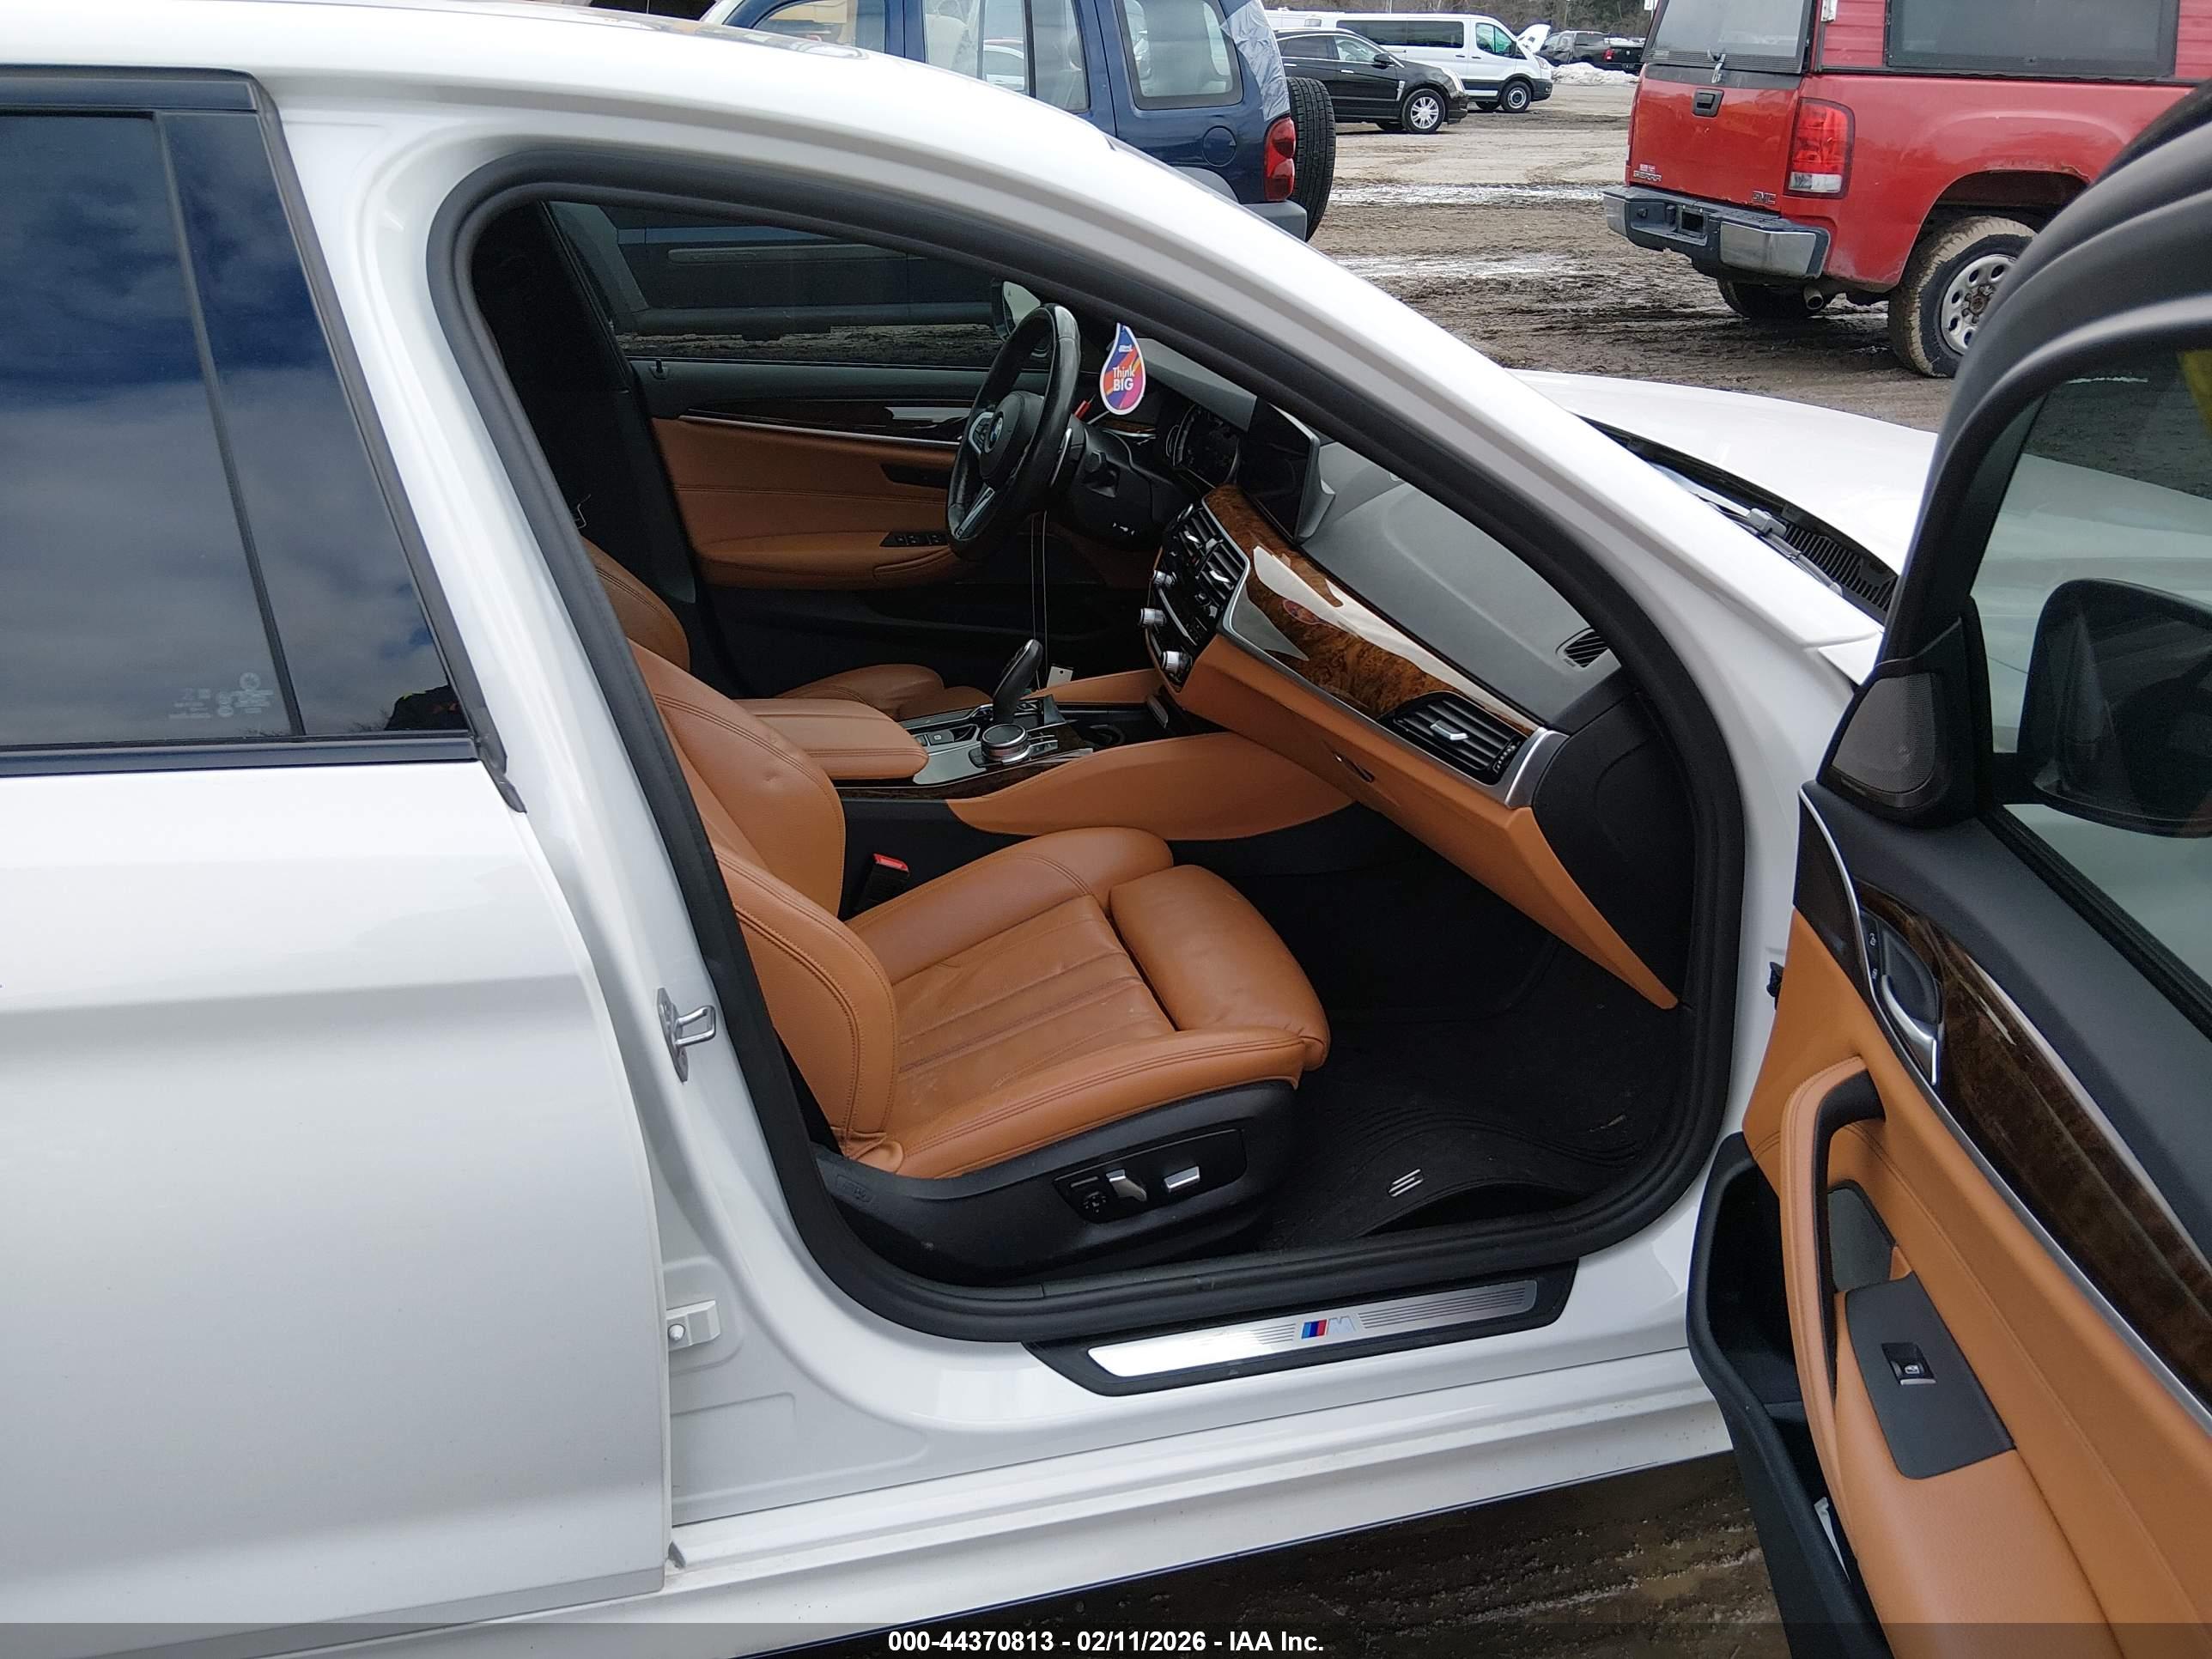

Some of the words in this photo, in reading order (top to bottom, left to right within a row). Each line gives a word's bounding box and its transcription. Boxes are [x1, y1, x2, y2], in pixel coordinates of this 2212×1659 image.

[1753, 191, 1777, 205] GMC
[1113, 364, 1135, 379] Think
[1113, 378, 1134, 392] BIG
